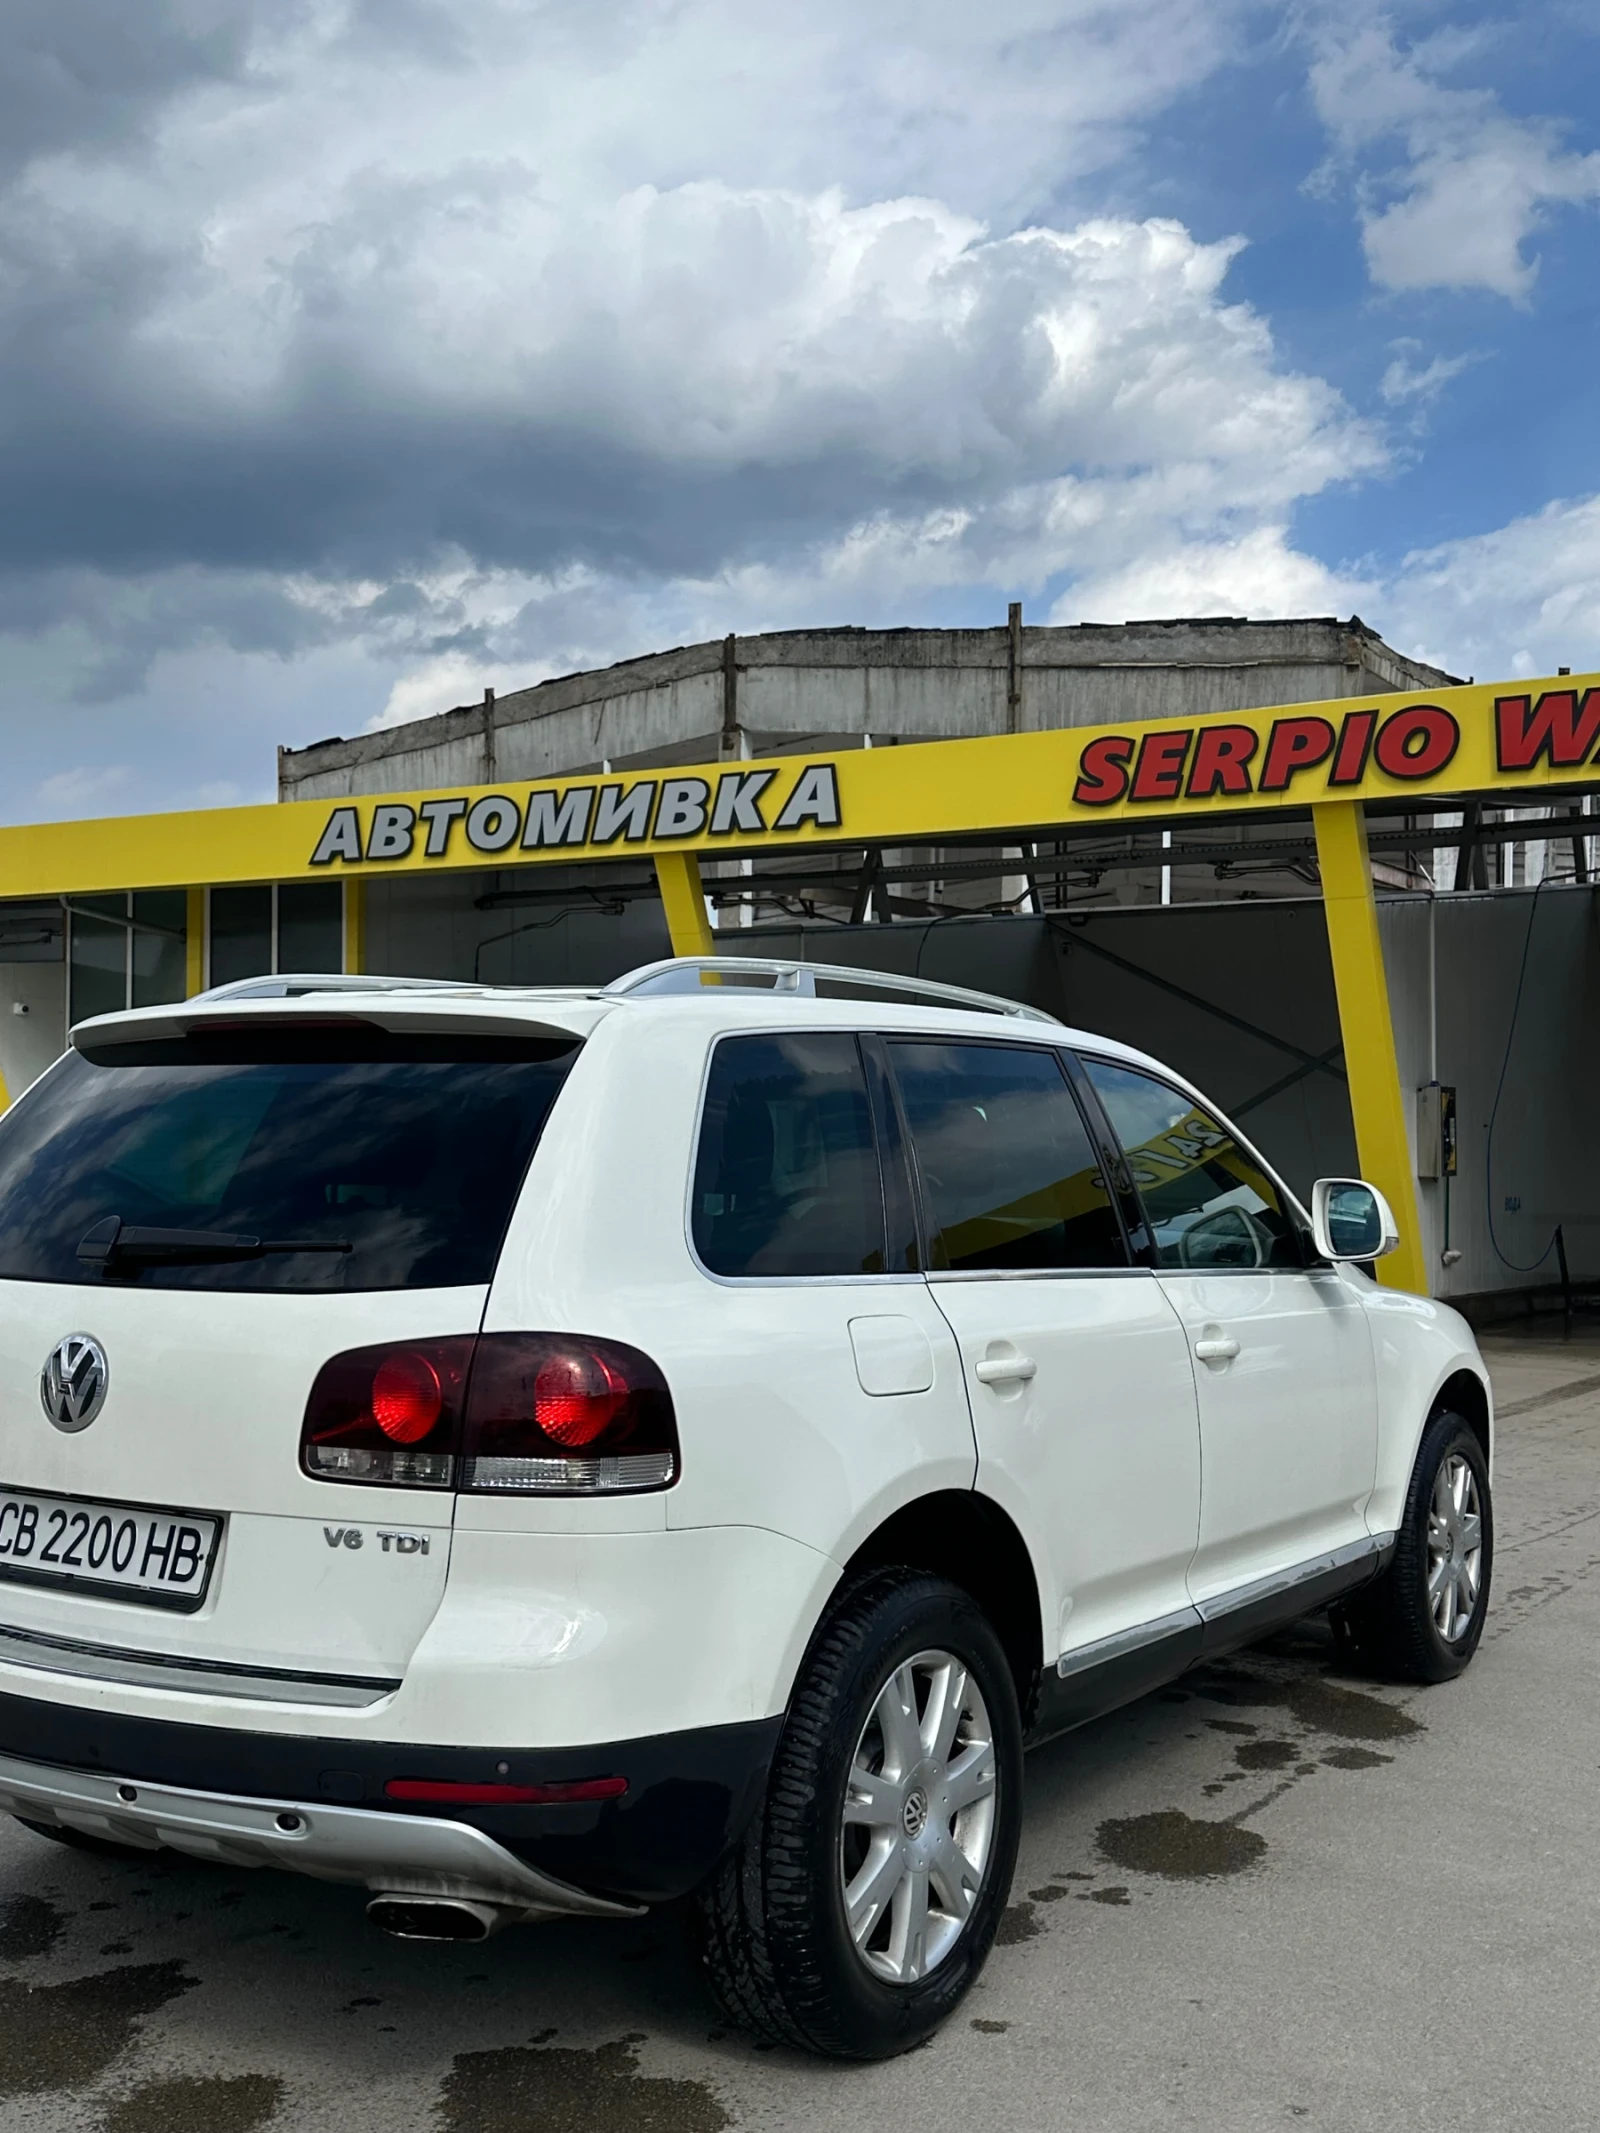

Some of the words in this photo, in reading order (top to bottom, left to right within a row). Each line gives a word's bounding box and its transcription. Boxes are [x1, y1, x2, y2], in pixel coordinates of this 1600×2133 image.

[1072, 704, 1461, 806] SERPIO
[1494, 686, 1600, 772] W
[308, 763, 842, 865] АВТОМИВКА
[0, 1502, 39, 1556] CB
[40, 1509, 137, 1572] 2200
[139, 1521, 202, 1583] HB
[323, 1526, 364, 1550] V6
[376, 1530, 430, 1555] TDI
